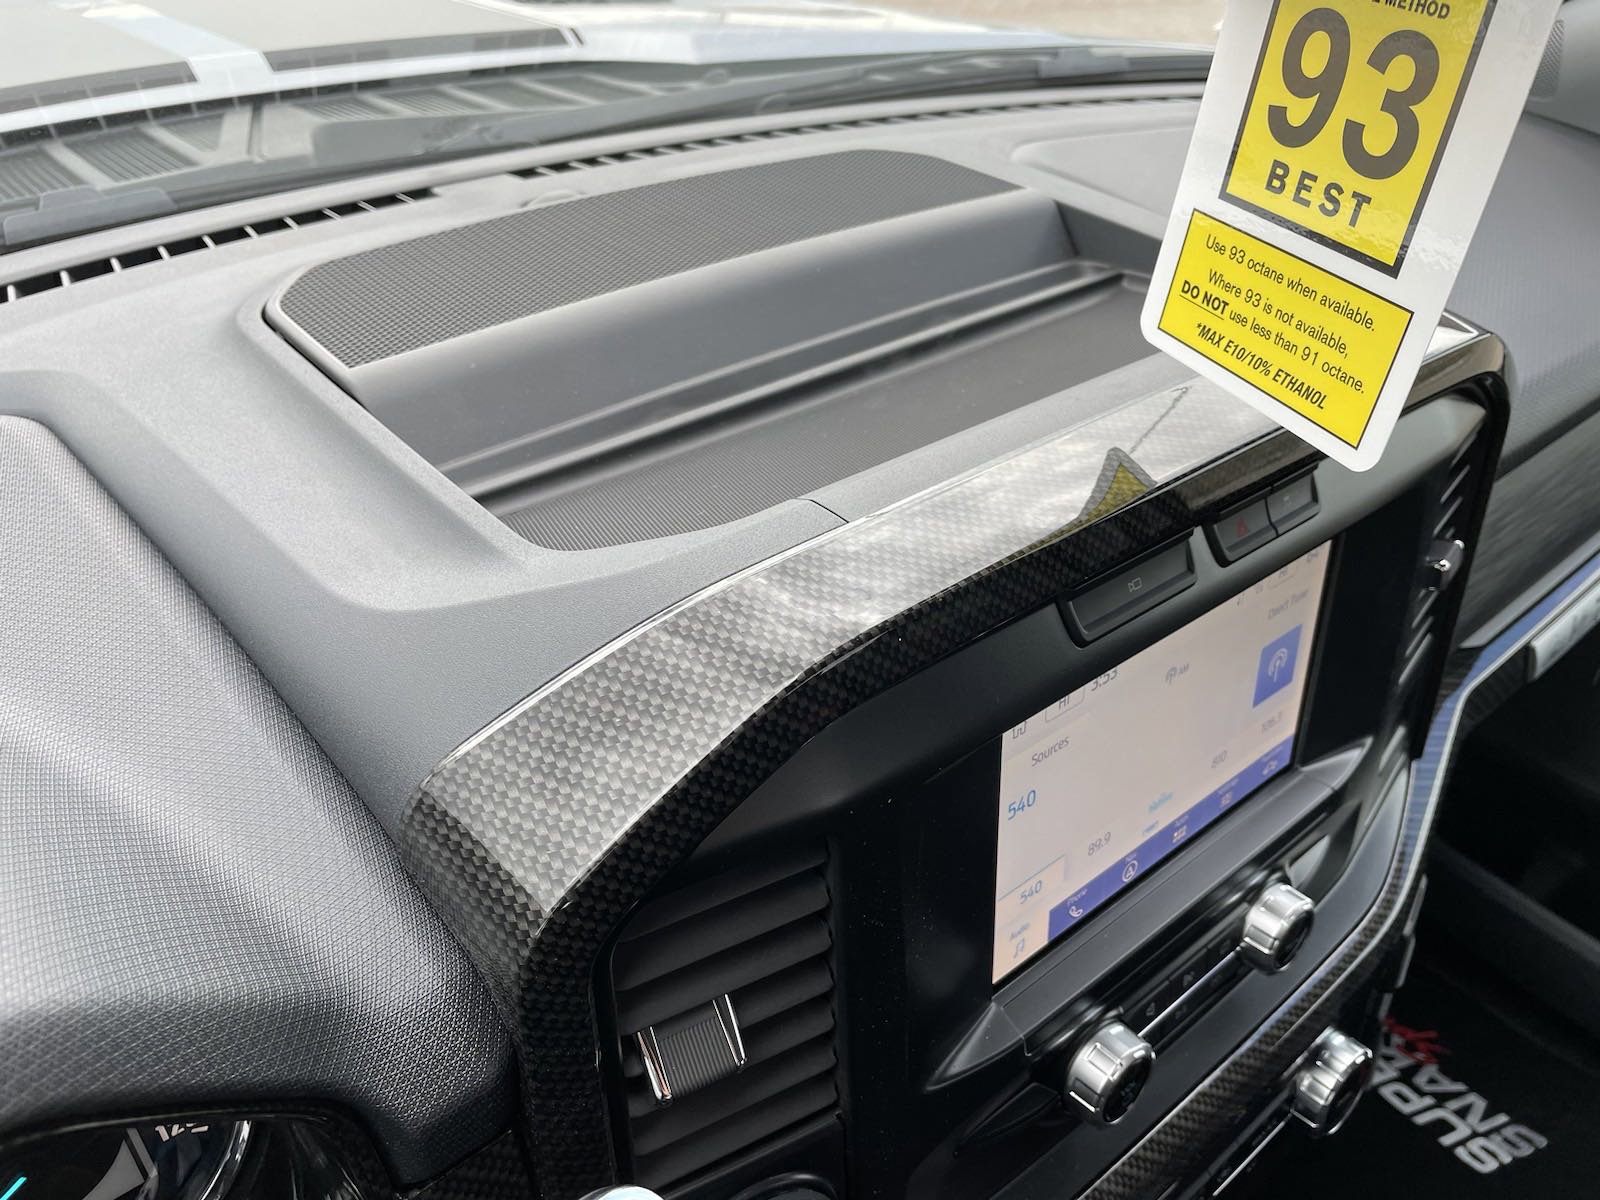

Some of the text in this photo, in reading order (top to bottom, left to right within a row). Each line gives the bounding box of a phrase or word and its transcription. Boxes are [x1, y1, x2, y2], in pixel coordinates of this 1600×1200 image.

[1267, 7, 1440, 180] 93
[1264, 159, 1372, 228] BEST
[1206, 234, 1375, 332] Use 93 octane when available.
[1208, 268, 1349, 359] Where 93 is not available,
[1181, 280, 1365, 395] DO NOT use less than 91 octane.
[1224, 337, 1272, 377] E10/10%
[1273, 368, 1329, 410] ETHANOL
[1031, 736, 1070, 766] Sources
[1007, 789, 1037, 821] 540
[1019, 880, 1043, 905] 540
[1087, 831, 1112, 856] 89.9
